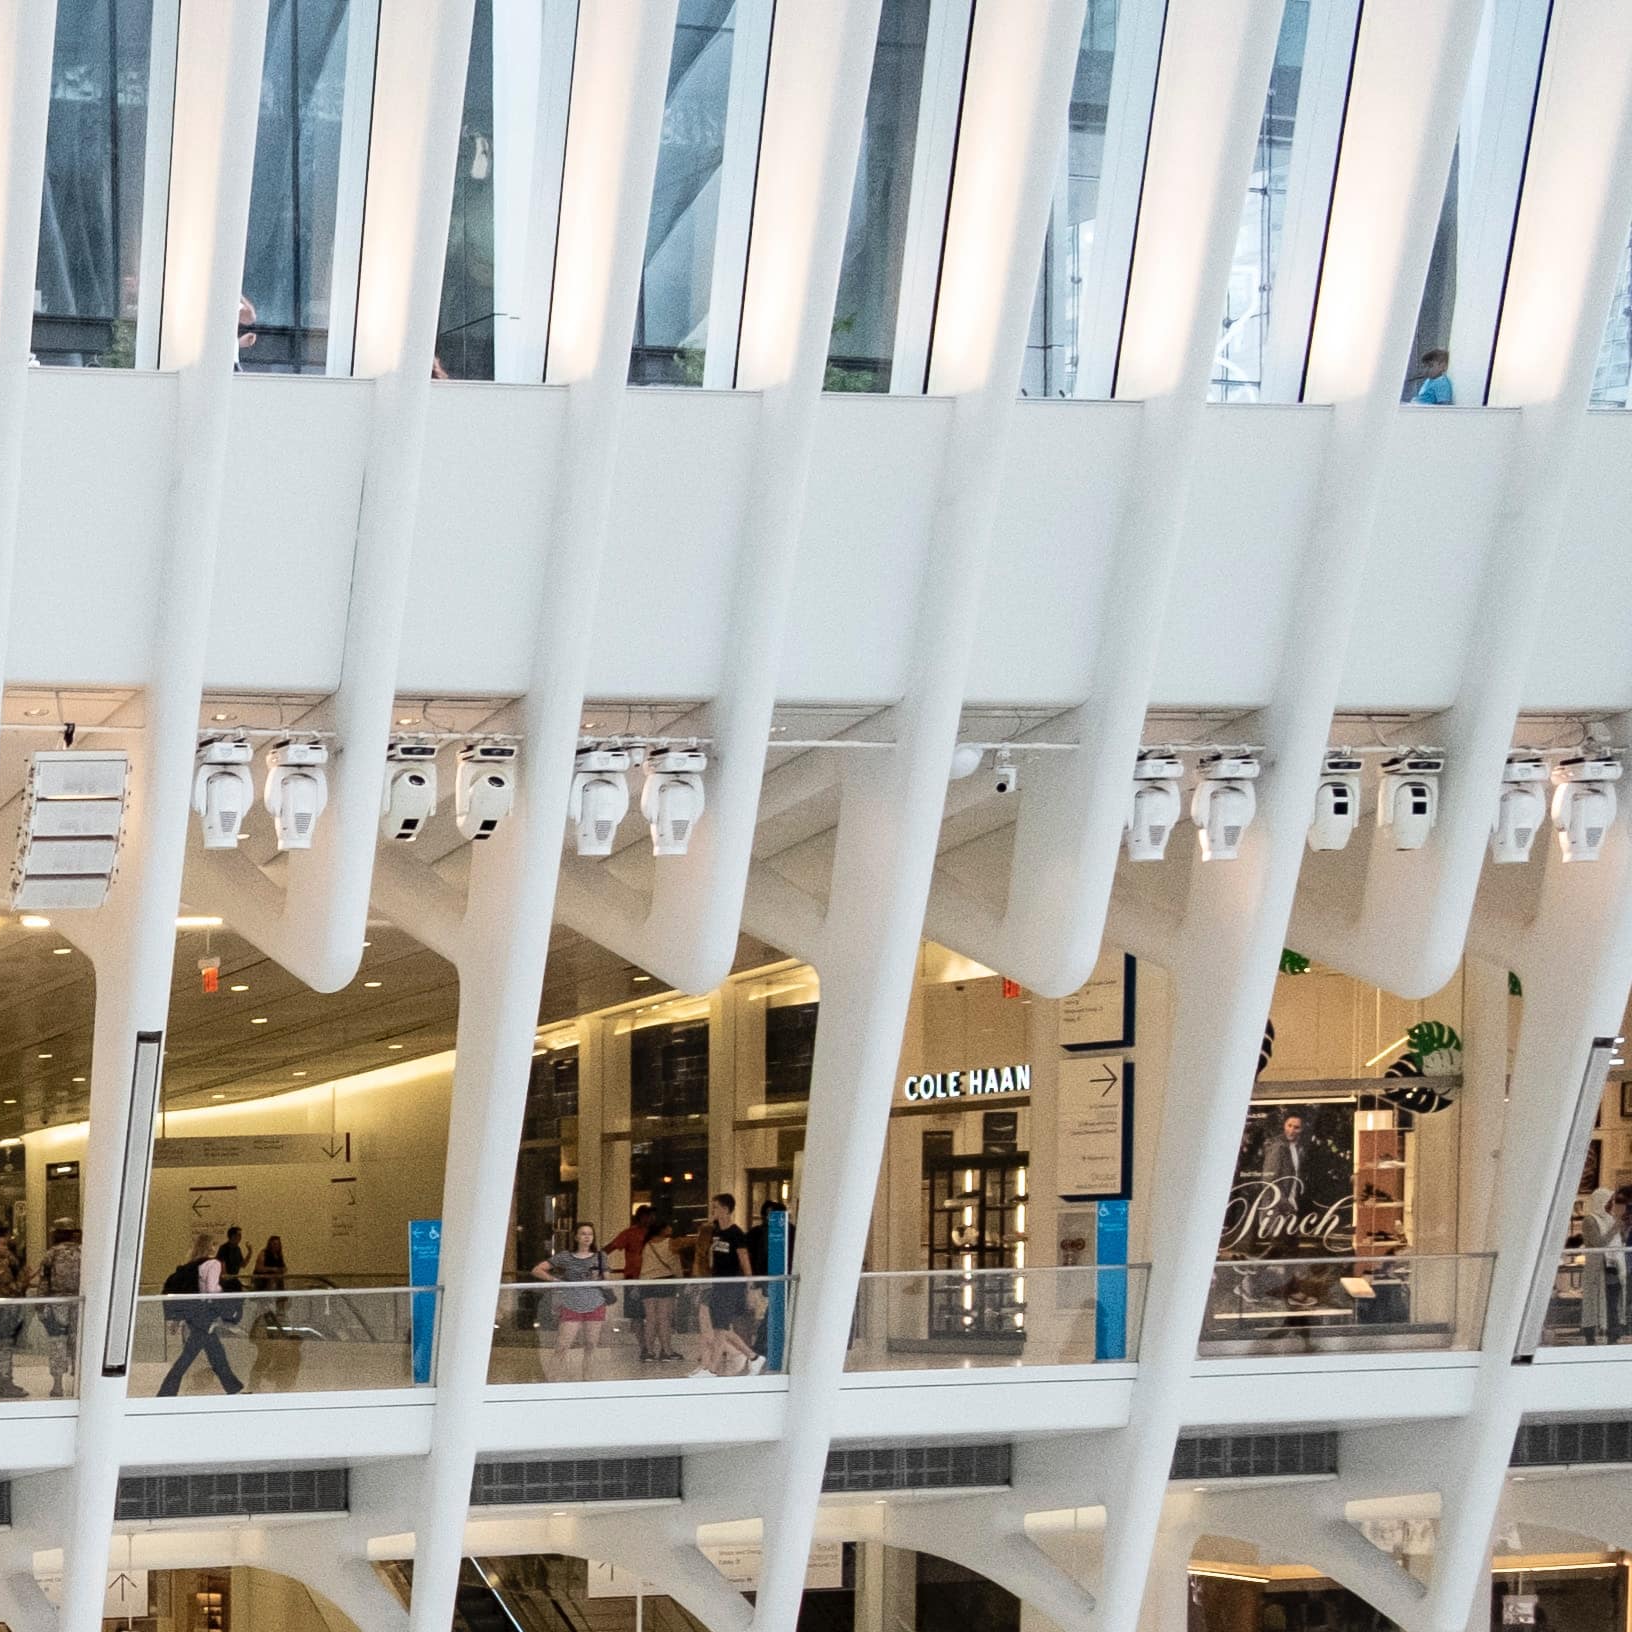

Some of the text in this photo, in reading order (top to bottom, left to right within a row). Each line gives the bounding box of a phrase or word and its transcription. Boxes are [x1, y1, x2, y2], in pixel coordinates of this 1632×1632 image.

[904, 1064, 1031, 1101] COLE HAAN
[1221, 1176, 1354, 1254] Pinch
